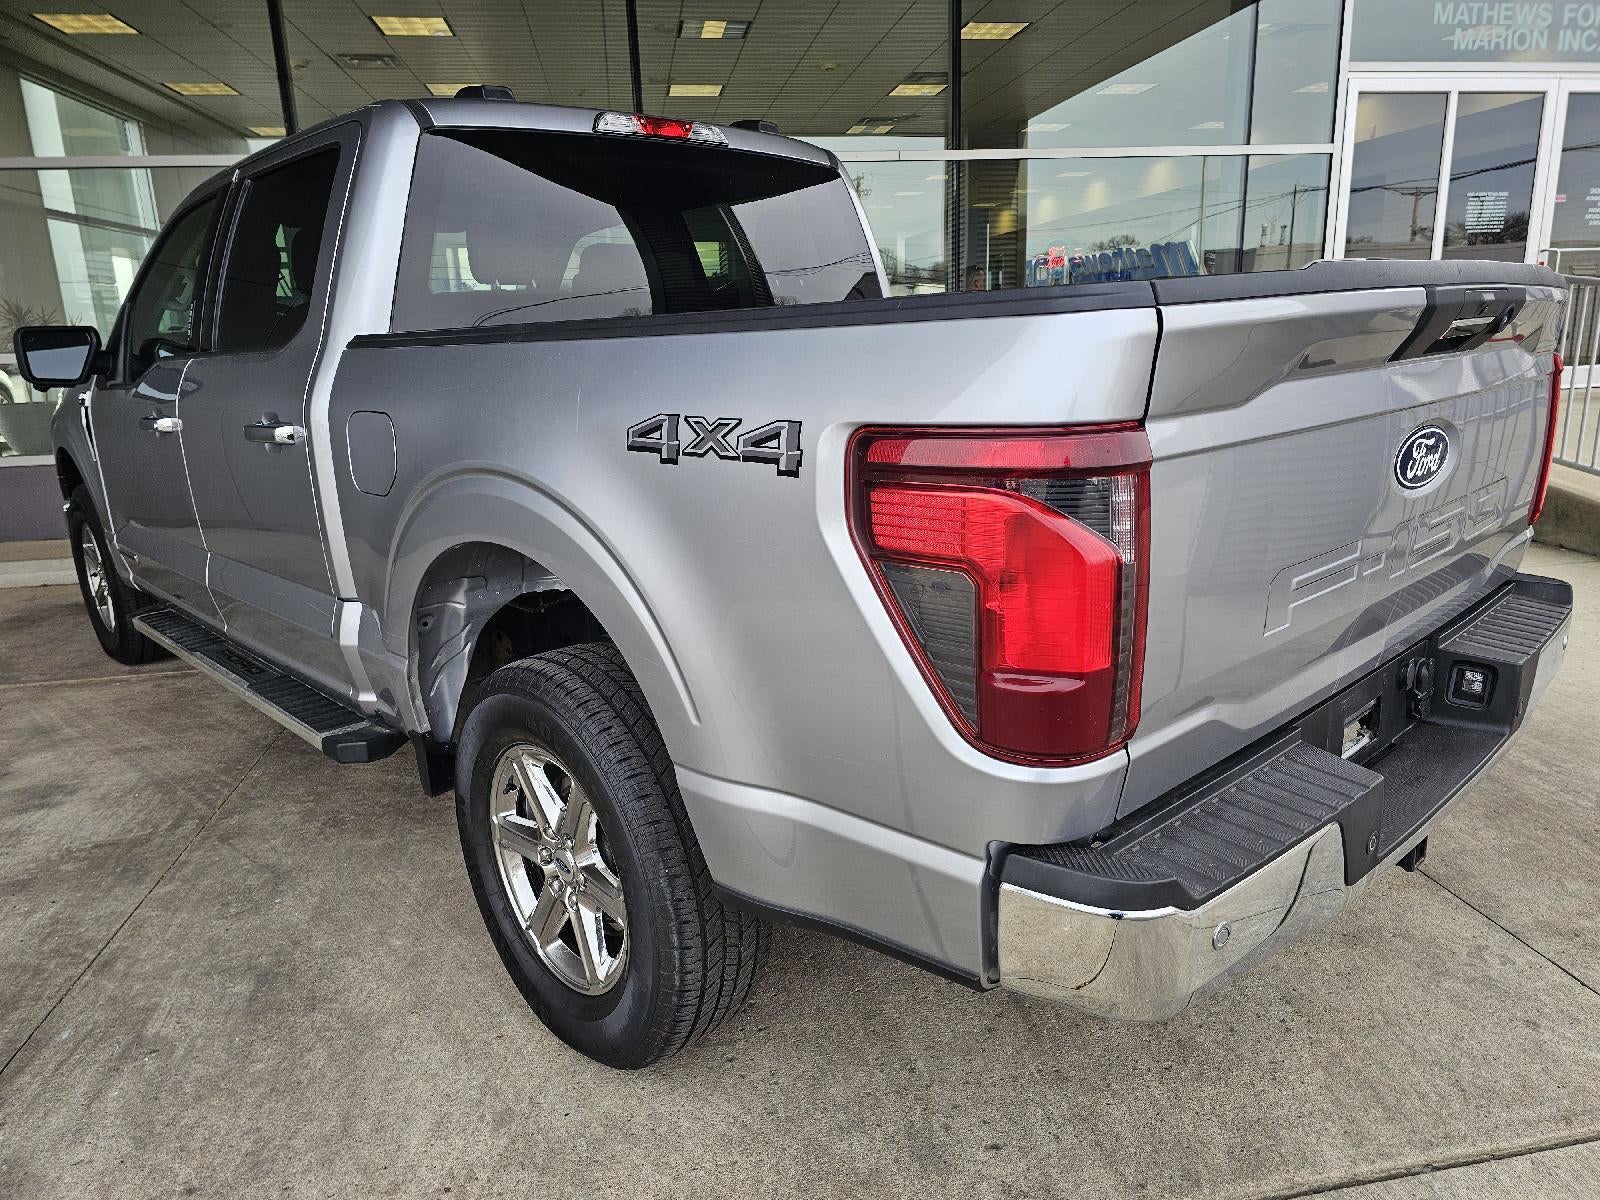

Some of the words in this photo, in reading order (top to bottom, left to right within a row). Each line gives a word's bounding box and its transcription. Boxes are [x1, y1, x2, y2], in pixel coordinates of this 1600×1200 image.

[1433, 1, 1553, 26] MATHEWS
[1562, 3, 1600, 27] FO
[1453, 28, 1550, 51] MARION
[1406, 436, 1443, 480] Ford
[1263, 476, 1508, 638] F-150
